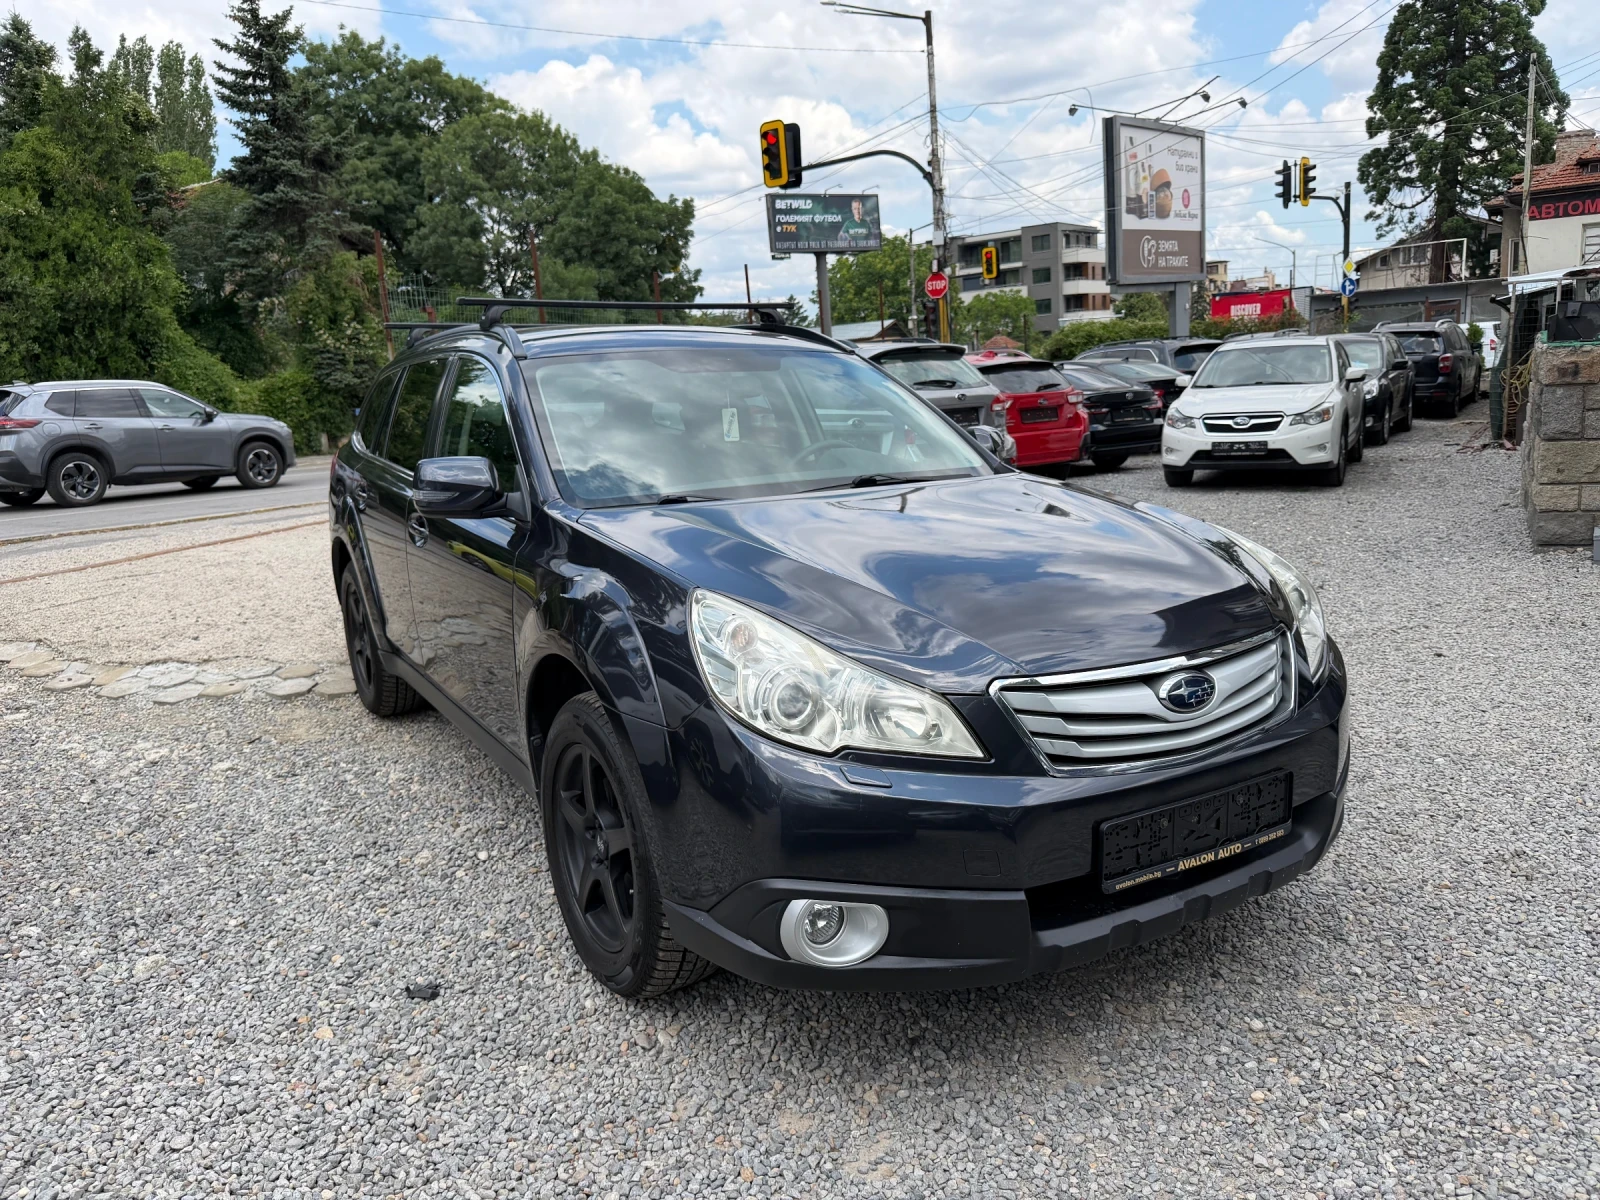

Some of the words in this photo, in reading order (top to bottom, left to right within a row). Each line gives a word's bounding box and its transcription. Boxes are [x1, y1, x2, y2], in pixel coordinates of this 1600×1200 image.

[775, 199, 813, 209] BETWILD
[1528, 198, 1600, 219] АВТОМ
[775, 214, 813, 223] ГОЛЕМИЯТ
[813, 214, 842, 223] ФУТБОЛ
[782, 224, 797, 232] ТУК
[1158, 240, 1178, 251] ЗЕМЯТА
[1158, 256, 1166, 267] НА
[1166, 255, 1189, 267] ТРАКИТЕ
[927, 280, 946, 291] STOP
[1230, 303, 1261, 316] DISCOVER
[1177, 851, 1215, 871] AVALON
[1217, 843, 1242, 860] AUTO
